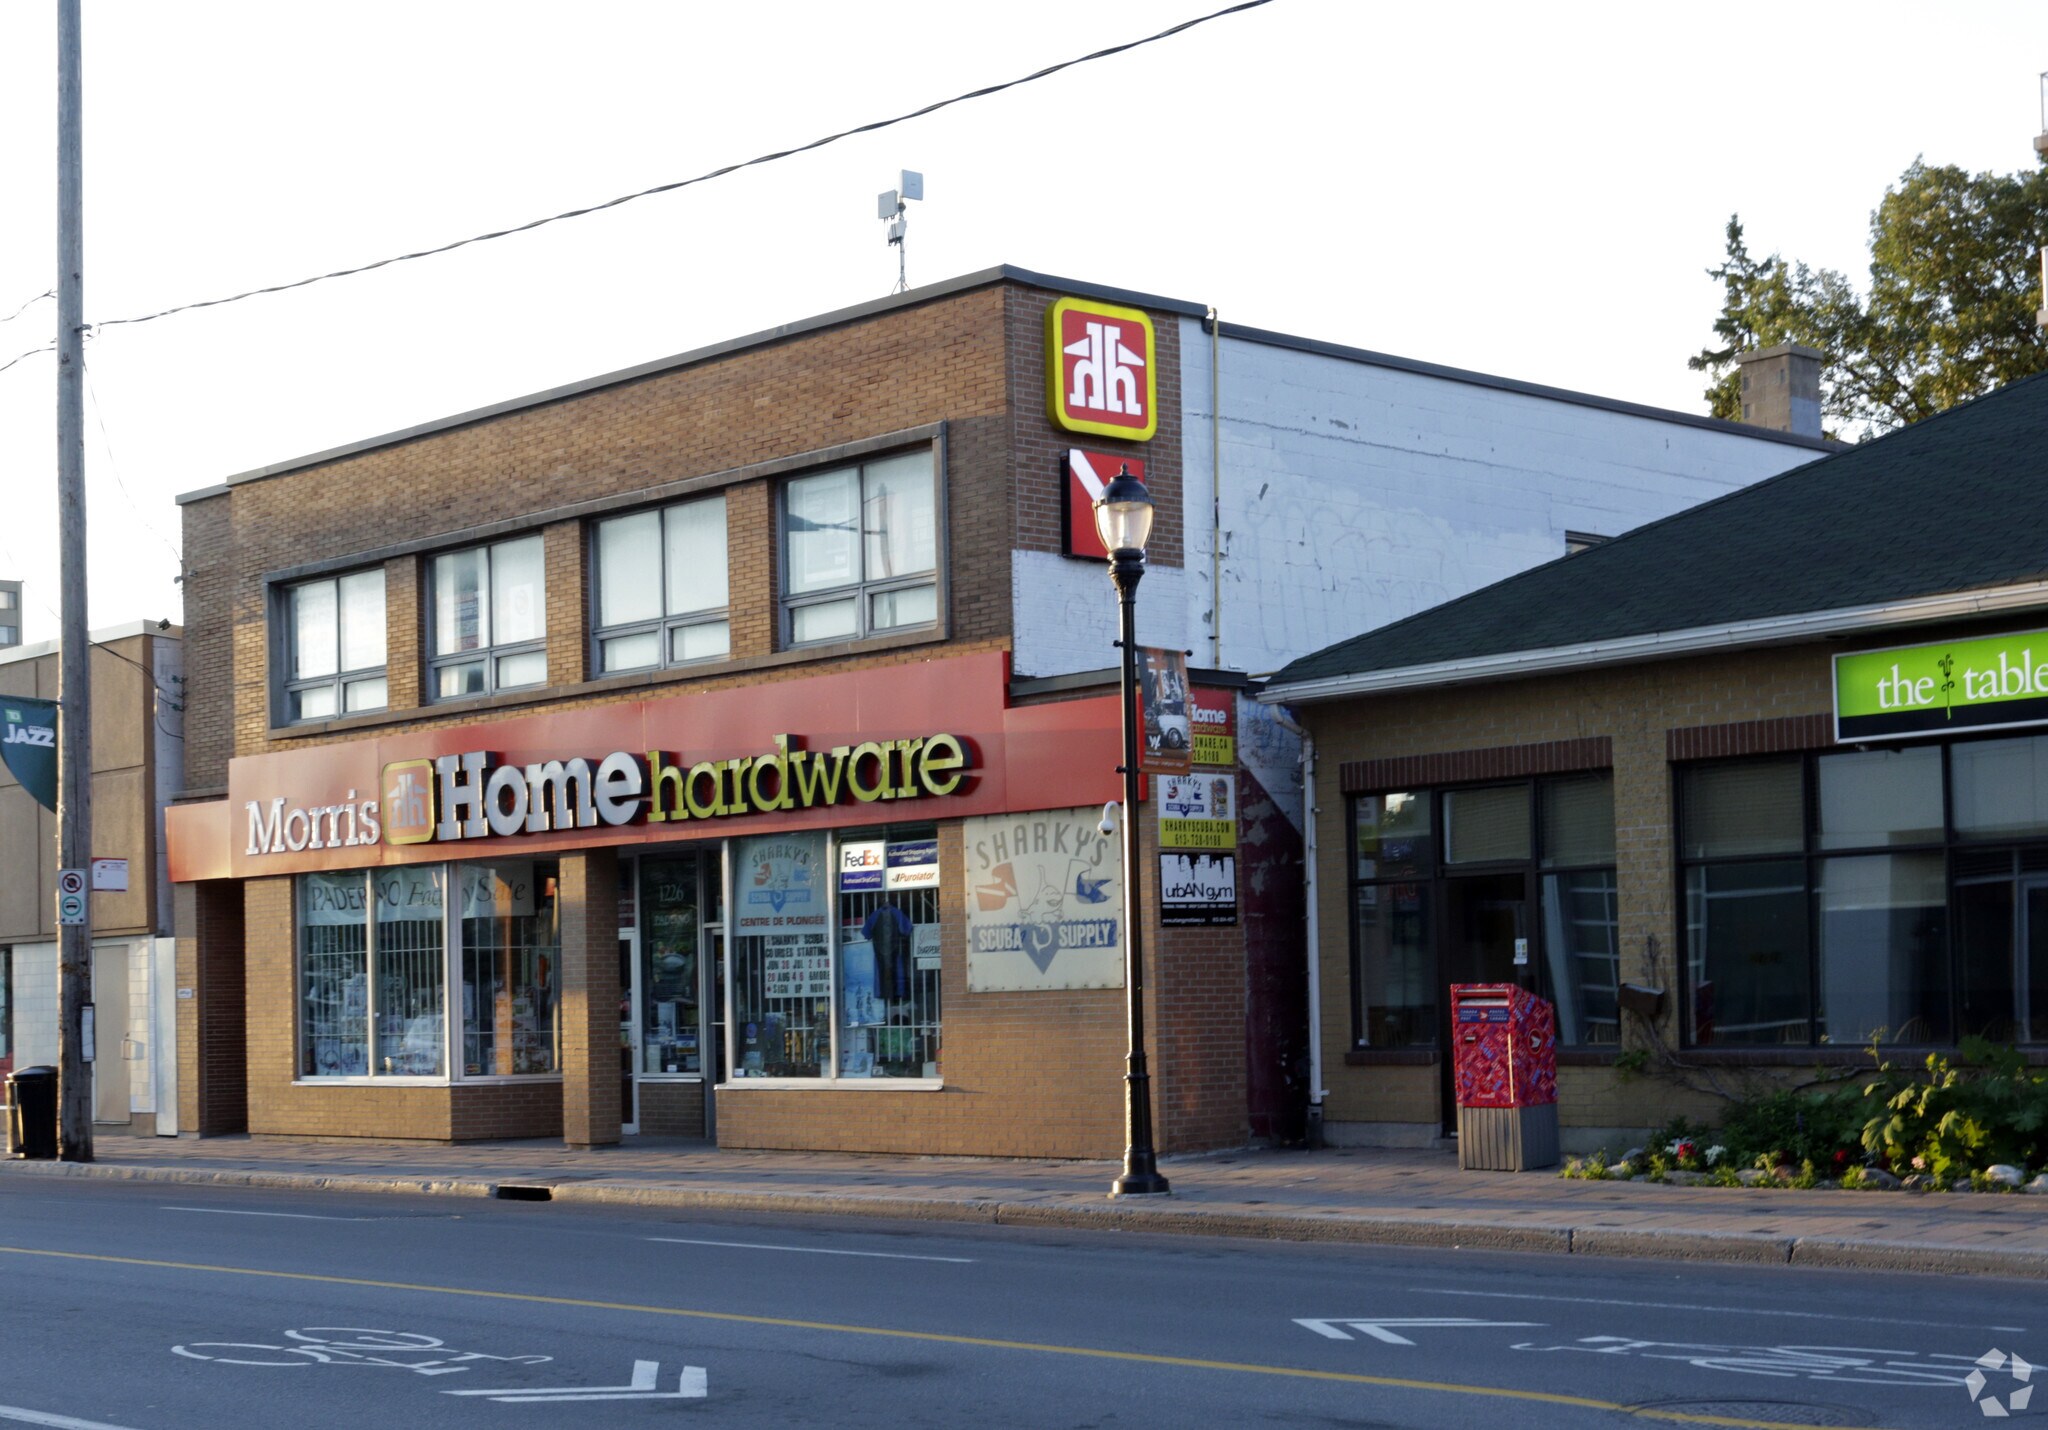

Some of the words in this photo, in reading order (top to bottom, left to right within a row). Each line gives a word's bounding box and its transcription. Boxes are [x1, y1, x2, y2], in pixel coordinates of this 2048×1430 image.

[1876, 663, 1935, 709] the
[1962, 648, 2048, 700] table
[1192, 723, 1227, 733] ardware
[3, 723, 55, 747] JAZZ
[1194, 736, 1228, 749] DWARE.CA
[1192, 750, 1219, 762] 28-0188
[245, 789, 381, 855] Morris
[436, 750, 643, 840] Home
[647, 733, 965, 821] hardware
[1165, 820, 1230, 833] SHARKYSCUBA.COM
[975, 821, 1109, 870] SHARKY'S
[752, 844, 810, 868] SHARKY'S
[844, 849, 880, 867] FedEx
[899, 872, 935, 882] Purolator
[659, 883, 685, 902] 1226
[1165, 882, 1205, 898] urbAN
[1206, 886, 1233, 901] gym
[740, 917, 770, 927] CENTRE
[773, 916, 784, 926] DE
[804, 934, 824, 945] SCUBA
[978, 927, 1024, 950] SCUBA
[1058, 922, 1112, 947] SUPPLY
[797, 946, 828, 957] STARTING
[777, 971, 790, 982] AUG
[794, 983, 803, 994] UP
